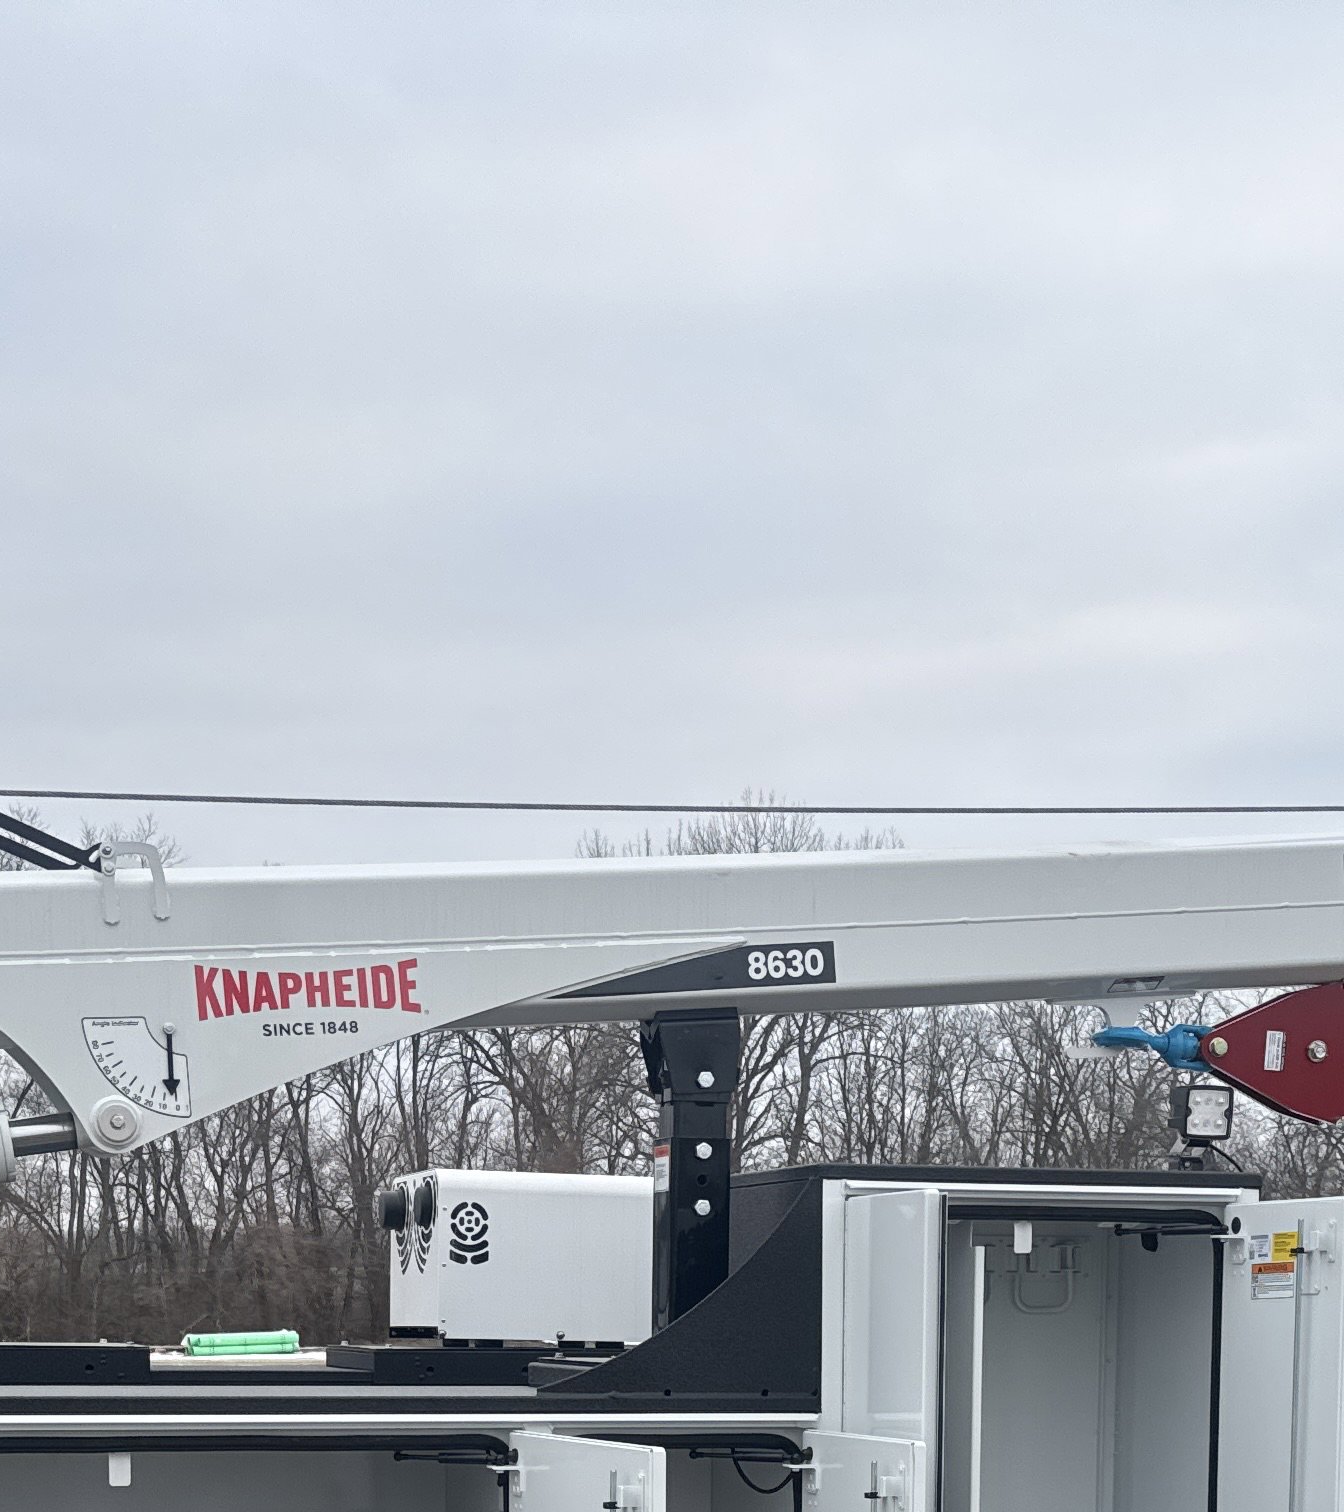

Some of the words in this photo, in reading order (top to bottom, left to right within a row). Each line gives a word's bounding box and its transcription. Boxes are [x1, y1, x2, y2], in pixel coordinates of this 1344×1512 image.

[747, 948, 825, 980] 8630
[193, 957, 423, 1022] KNAPHEIDE
[262, 1022, 316, 1037] SINCE
[320, 1020, 359, 1035] 1848
[96, 1053, 105, 1063] 70
[143, 1099, 154, 1108] 20
